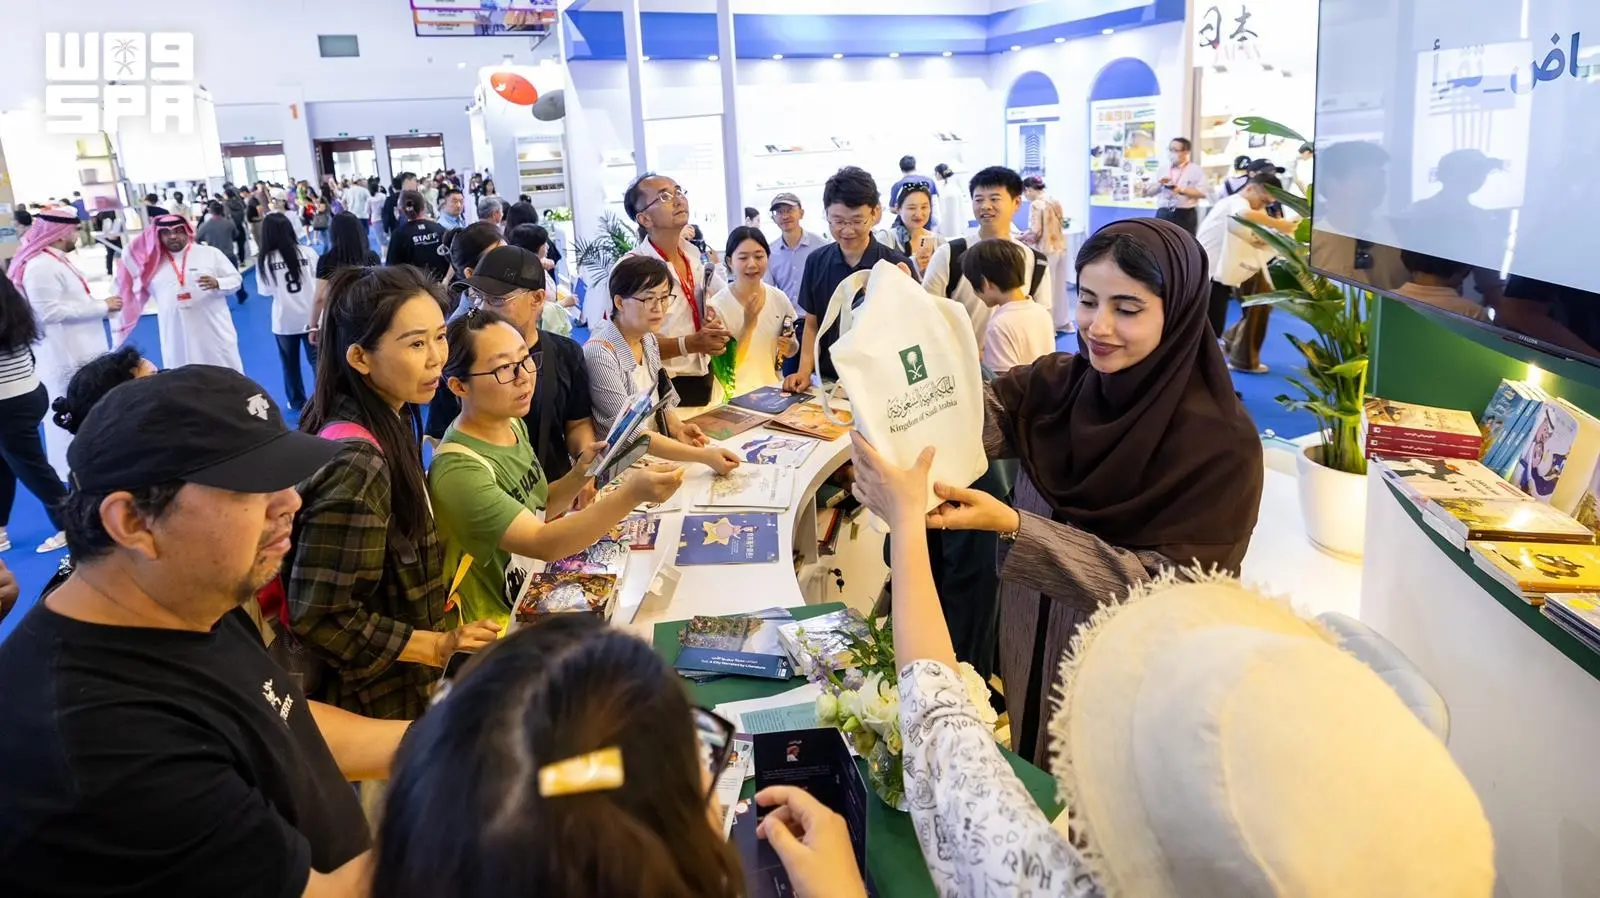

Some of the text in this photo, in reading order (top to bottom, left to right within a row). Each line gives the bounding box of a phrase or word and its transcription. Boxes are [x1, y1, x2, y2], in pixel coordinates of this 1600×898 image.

[1198, 4, 1259, 50] 日本
[412, 232, 438, 244] STAFF
[284, 270, 302, 294] 8
[889, 417, 919, 433] Kingdom
[925, 405, 938, 417] Saudi
[938, 399, 958, 410] Arabia
